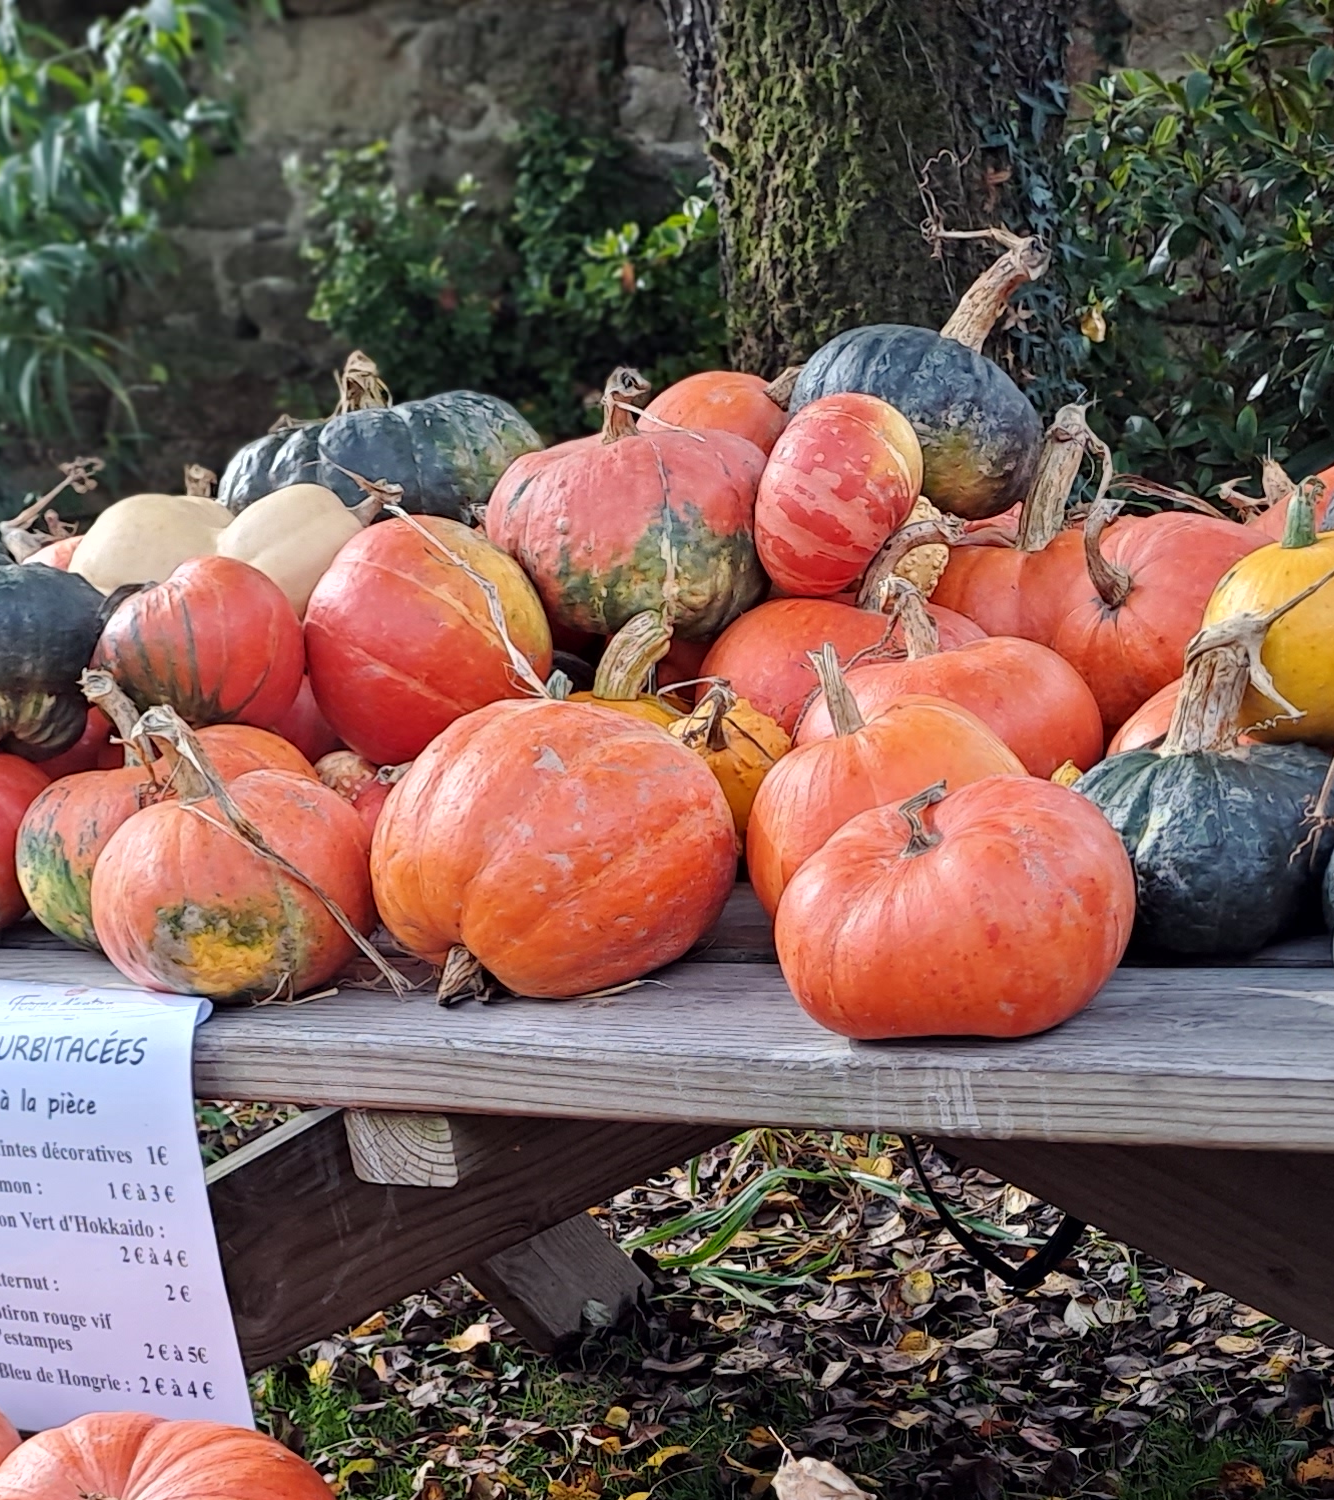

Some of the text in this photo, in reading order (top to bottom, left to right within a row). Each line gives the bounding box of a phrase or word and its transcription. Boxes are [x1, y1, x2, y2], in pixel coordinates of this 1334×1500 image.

[0, 1088, 97, 1120] à la pièce
[42, 1141, 133, 1165] décoratives
[147, 1145, 169, 1166] 1€
[19, 1211, 56, 1231] Vert
[59, 1215, 154, 1238] d'Hokkaido
[43, 1311, 87, 1332] rouge
[90, 1313, 112, 1330] vif
[36, 1366, 55, 1384] de
[57, 1368, 122, 1393] Hongrie
